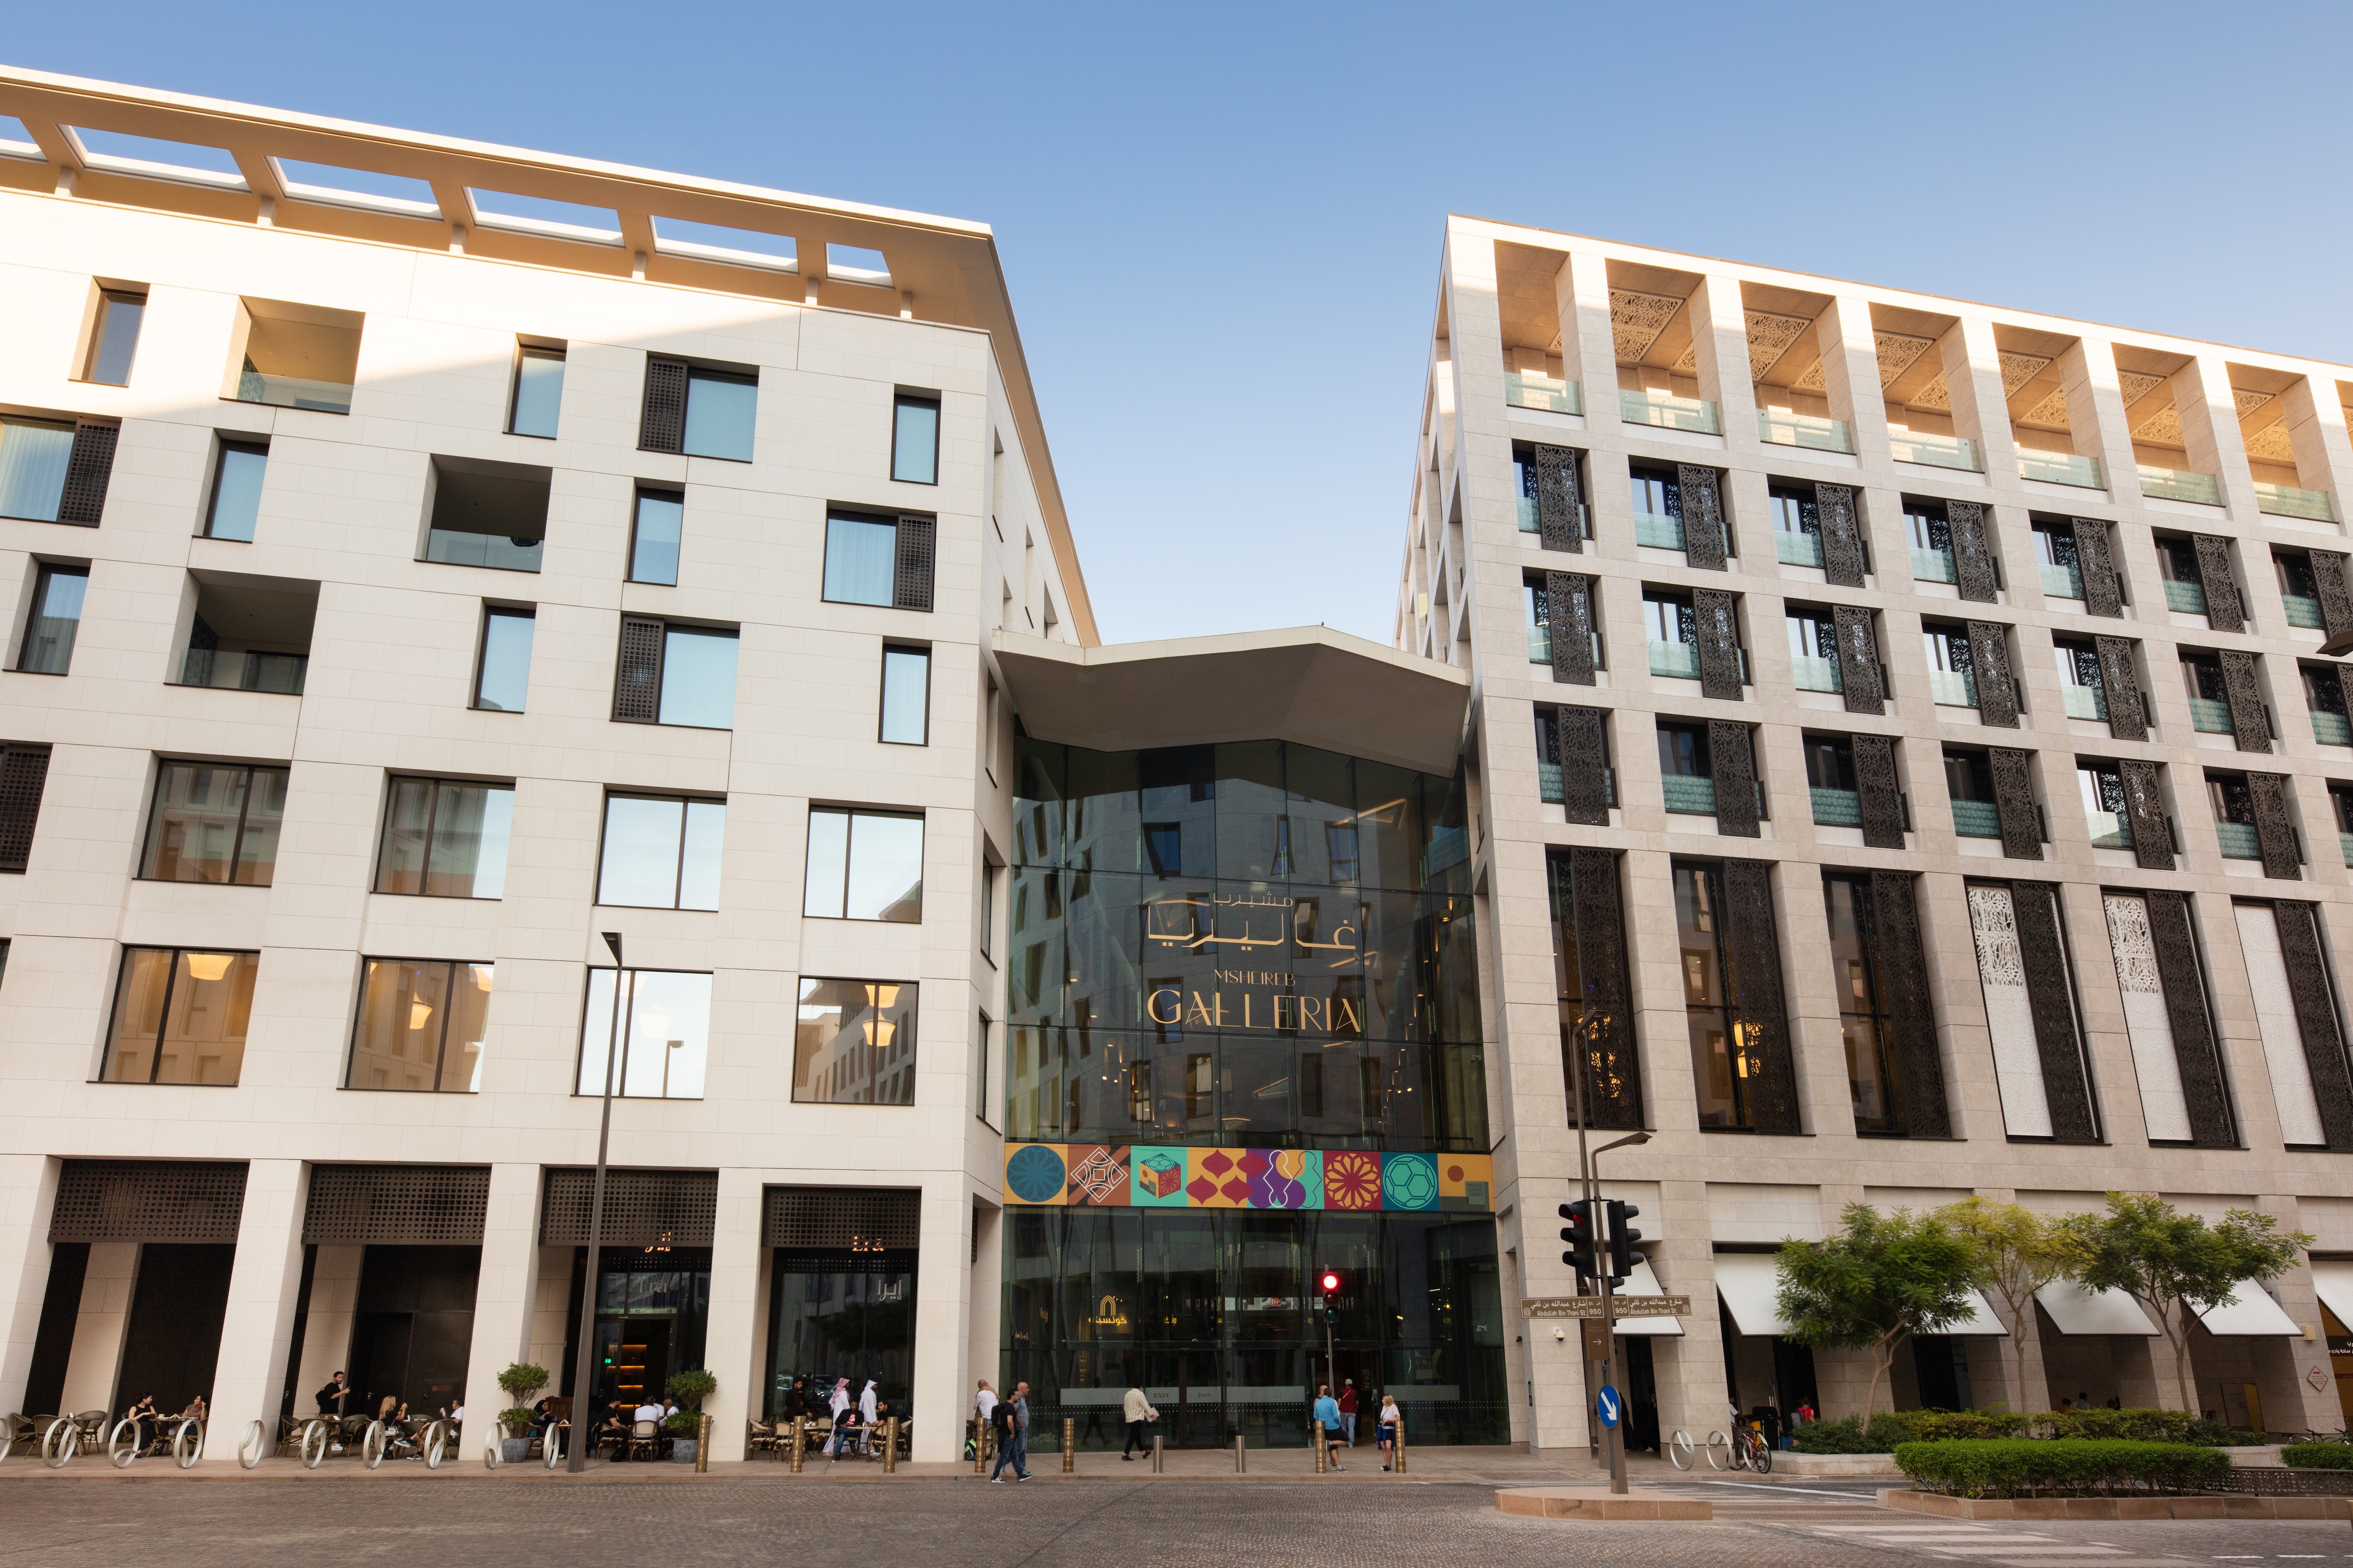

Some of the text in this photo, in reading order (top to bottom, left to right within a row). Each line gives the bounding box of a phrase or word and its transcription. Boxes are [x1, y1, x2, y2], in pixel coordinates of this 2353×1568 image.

[1214, 892, 1293, 908] مشيرب
[1148, 906, 1356, 951] غاليريا
[1214, 969, 1296, 986] MSHEIREB
[1147, 989, 1361, 1033] GALLERIA
[876, 1279, 902, 1301] إيرا
[1531, 1300, 1541, 1310] ثاني
[1551, 1300, 1569, 1308] عبدالله
[1572, 1300, 1587, 1309] شارع
[1629, 1299, 1639, 1309] ثاني
[1669, 1298, 1682, 1306] شارع
